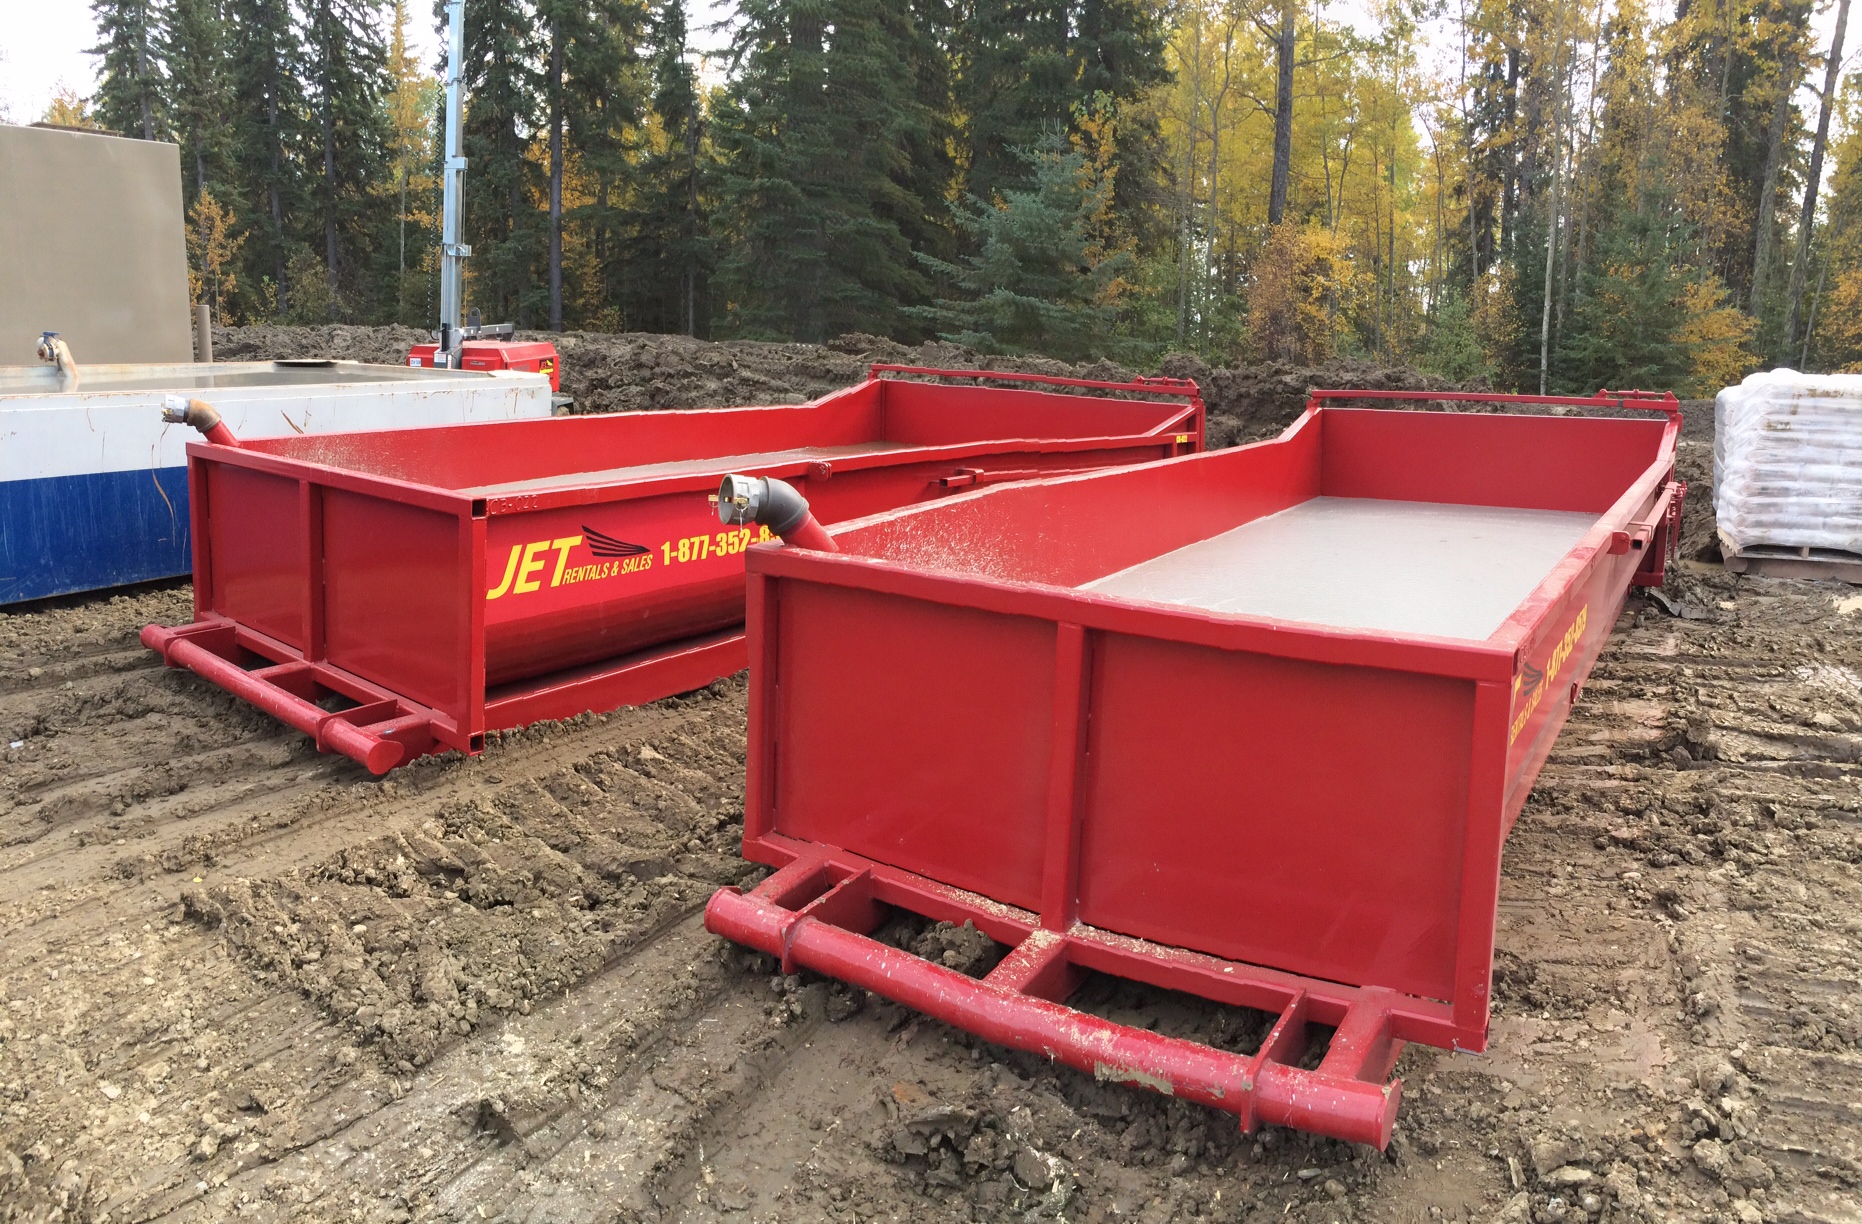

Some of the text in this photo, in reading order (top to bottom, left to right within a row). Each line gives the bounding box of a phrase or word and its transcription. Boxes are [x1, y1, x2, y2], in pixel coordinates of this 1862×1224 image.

[486, 535, 583, 600] JET
[562, 554, 653, 585] RENTALS & SALES
